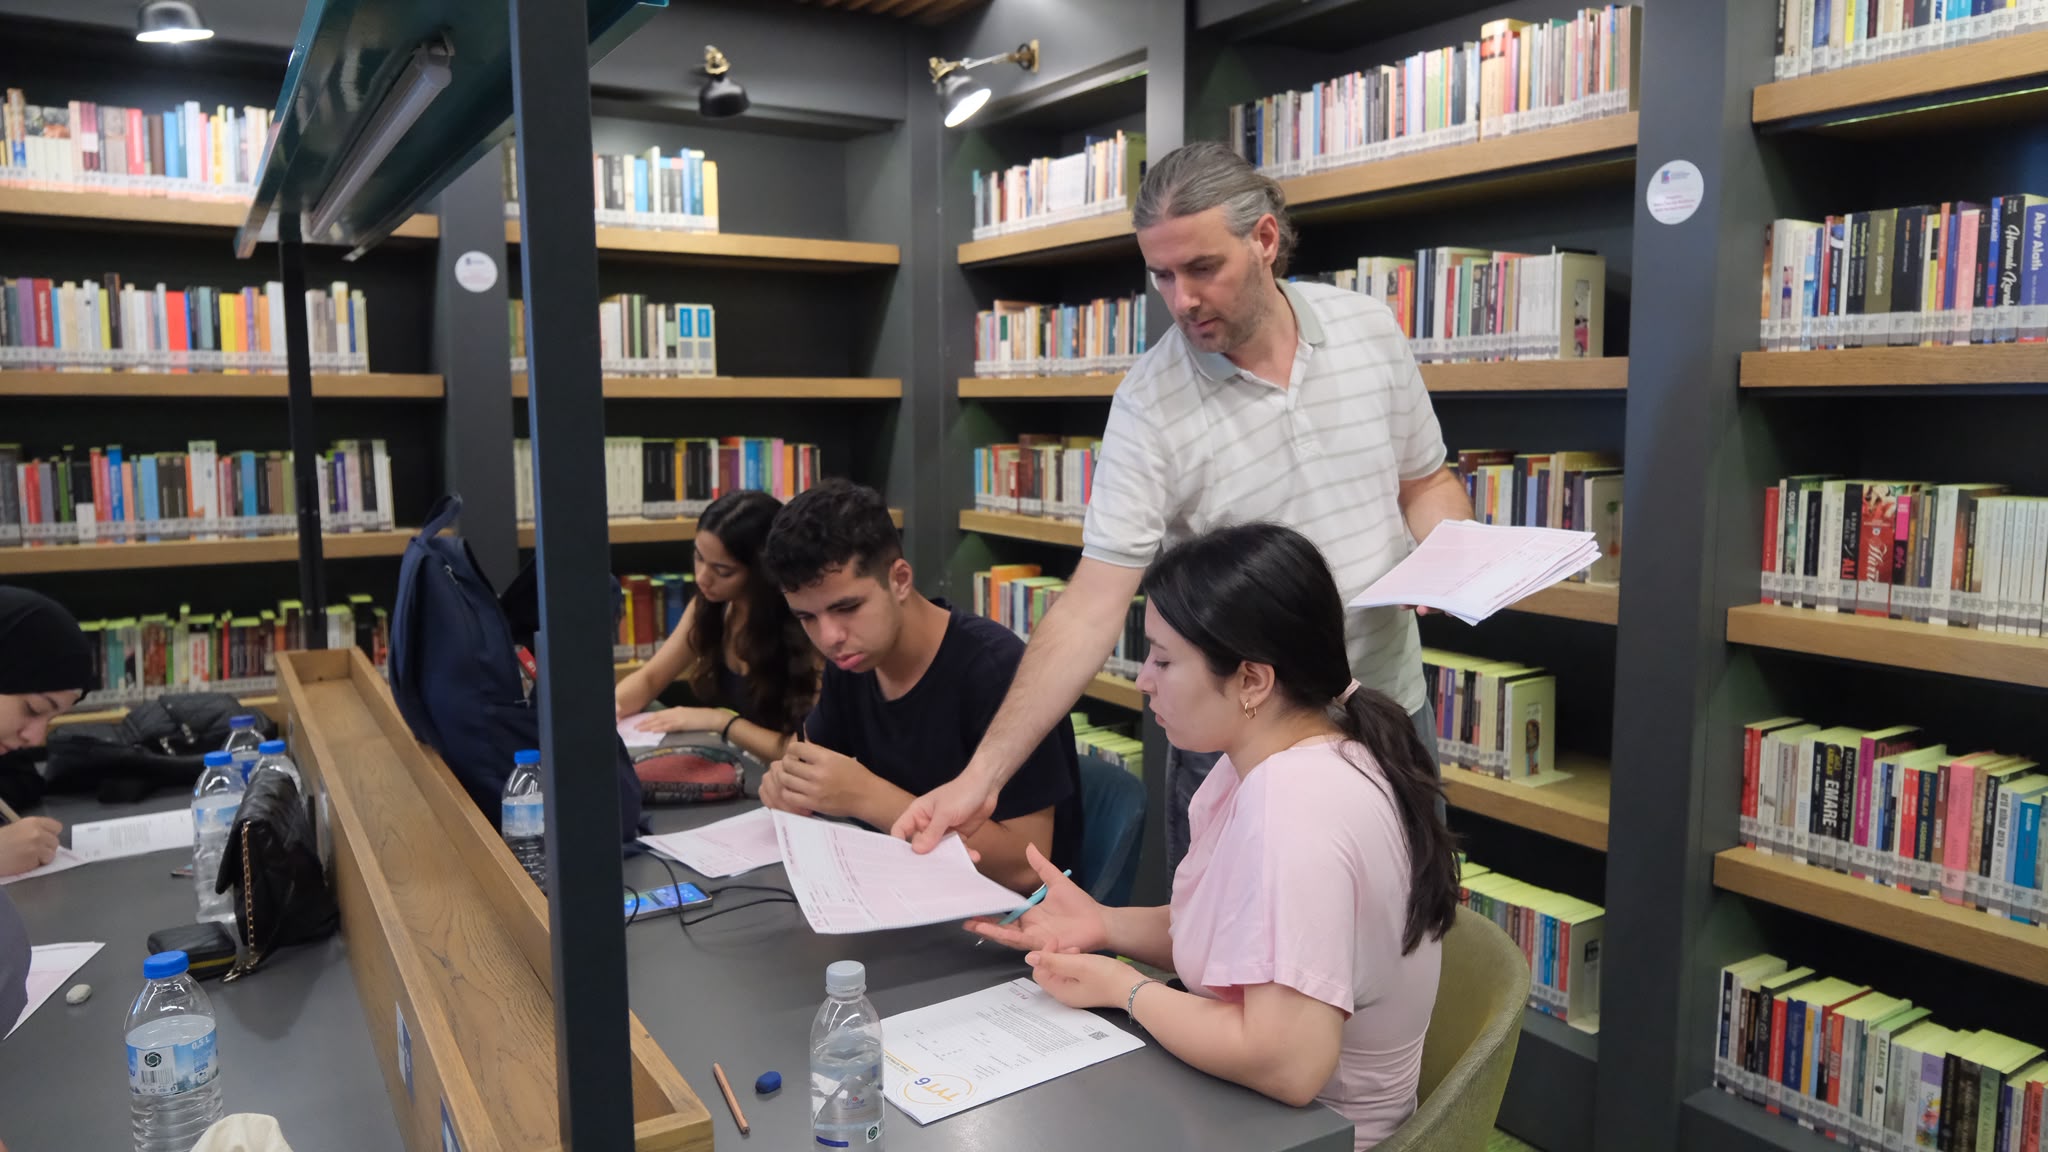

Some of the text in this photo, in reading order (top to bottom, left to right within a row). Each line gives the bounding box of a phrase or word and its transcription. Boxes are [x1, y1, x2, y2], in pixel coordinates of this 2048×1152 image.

[2033, 211, 2047, 239] Alev
[2030, 240, 2045, 271] Alatlı
[1822, 779, 1840, 828] EMARE
[921, 1082, 961, 1102] TYT
